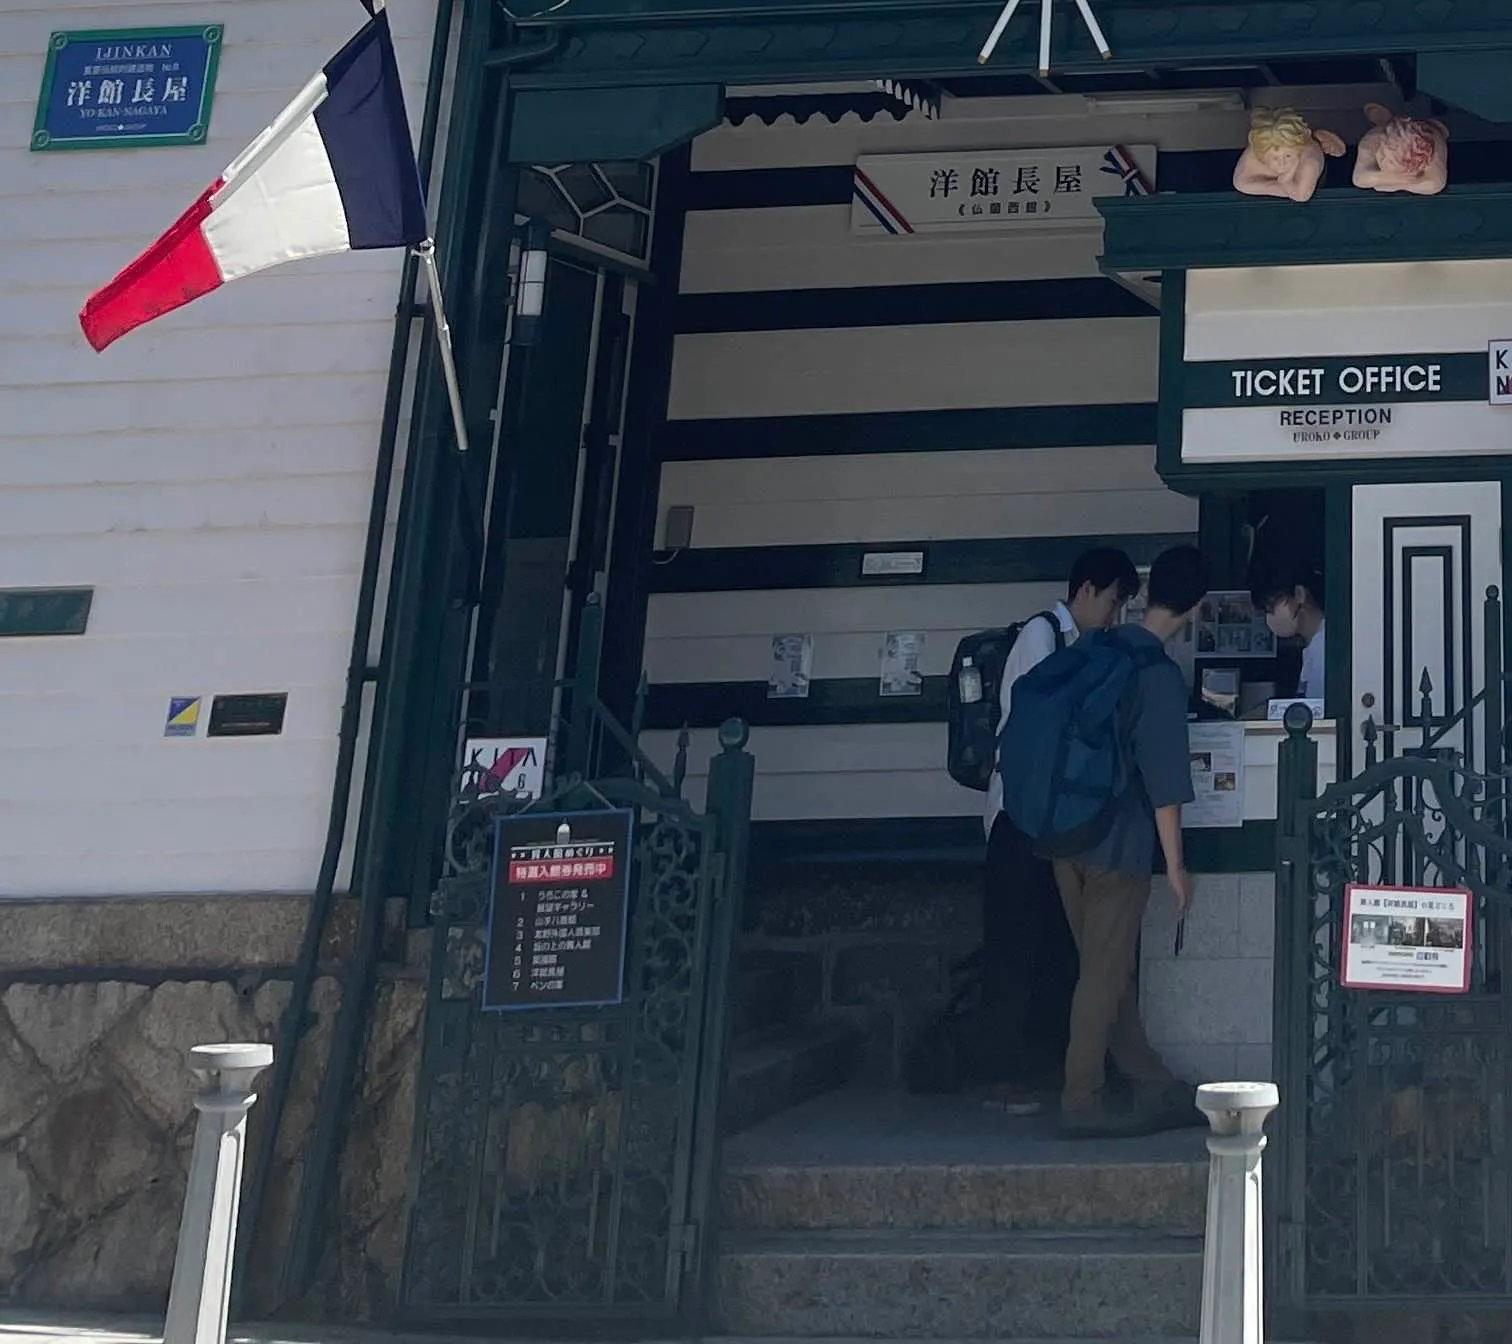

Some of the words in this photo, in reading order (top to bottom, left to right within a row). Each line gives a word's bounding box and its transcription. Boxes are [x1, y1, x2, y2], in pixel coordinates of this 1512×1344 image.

[96, 44, 172, 60] IJINKAN
[67, 76, 187, 106] 洋館長屋
[930, 165, 1082, 198] 洋館長屋
[1232, 368, 1324, 397] TICKET
[1339, 365, 1441, 393] OFFICE
[1280, 408, 1391, 426] RECEPTION
[1293, 431, 1330, 442] UROKO
[1343, 428, 1380, 440] GROUP
[517, 918, 524, 927] 2
[515, 944, 522, 952] 4
[512, 982, 519, 990] 7
